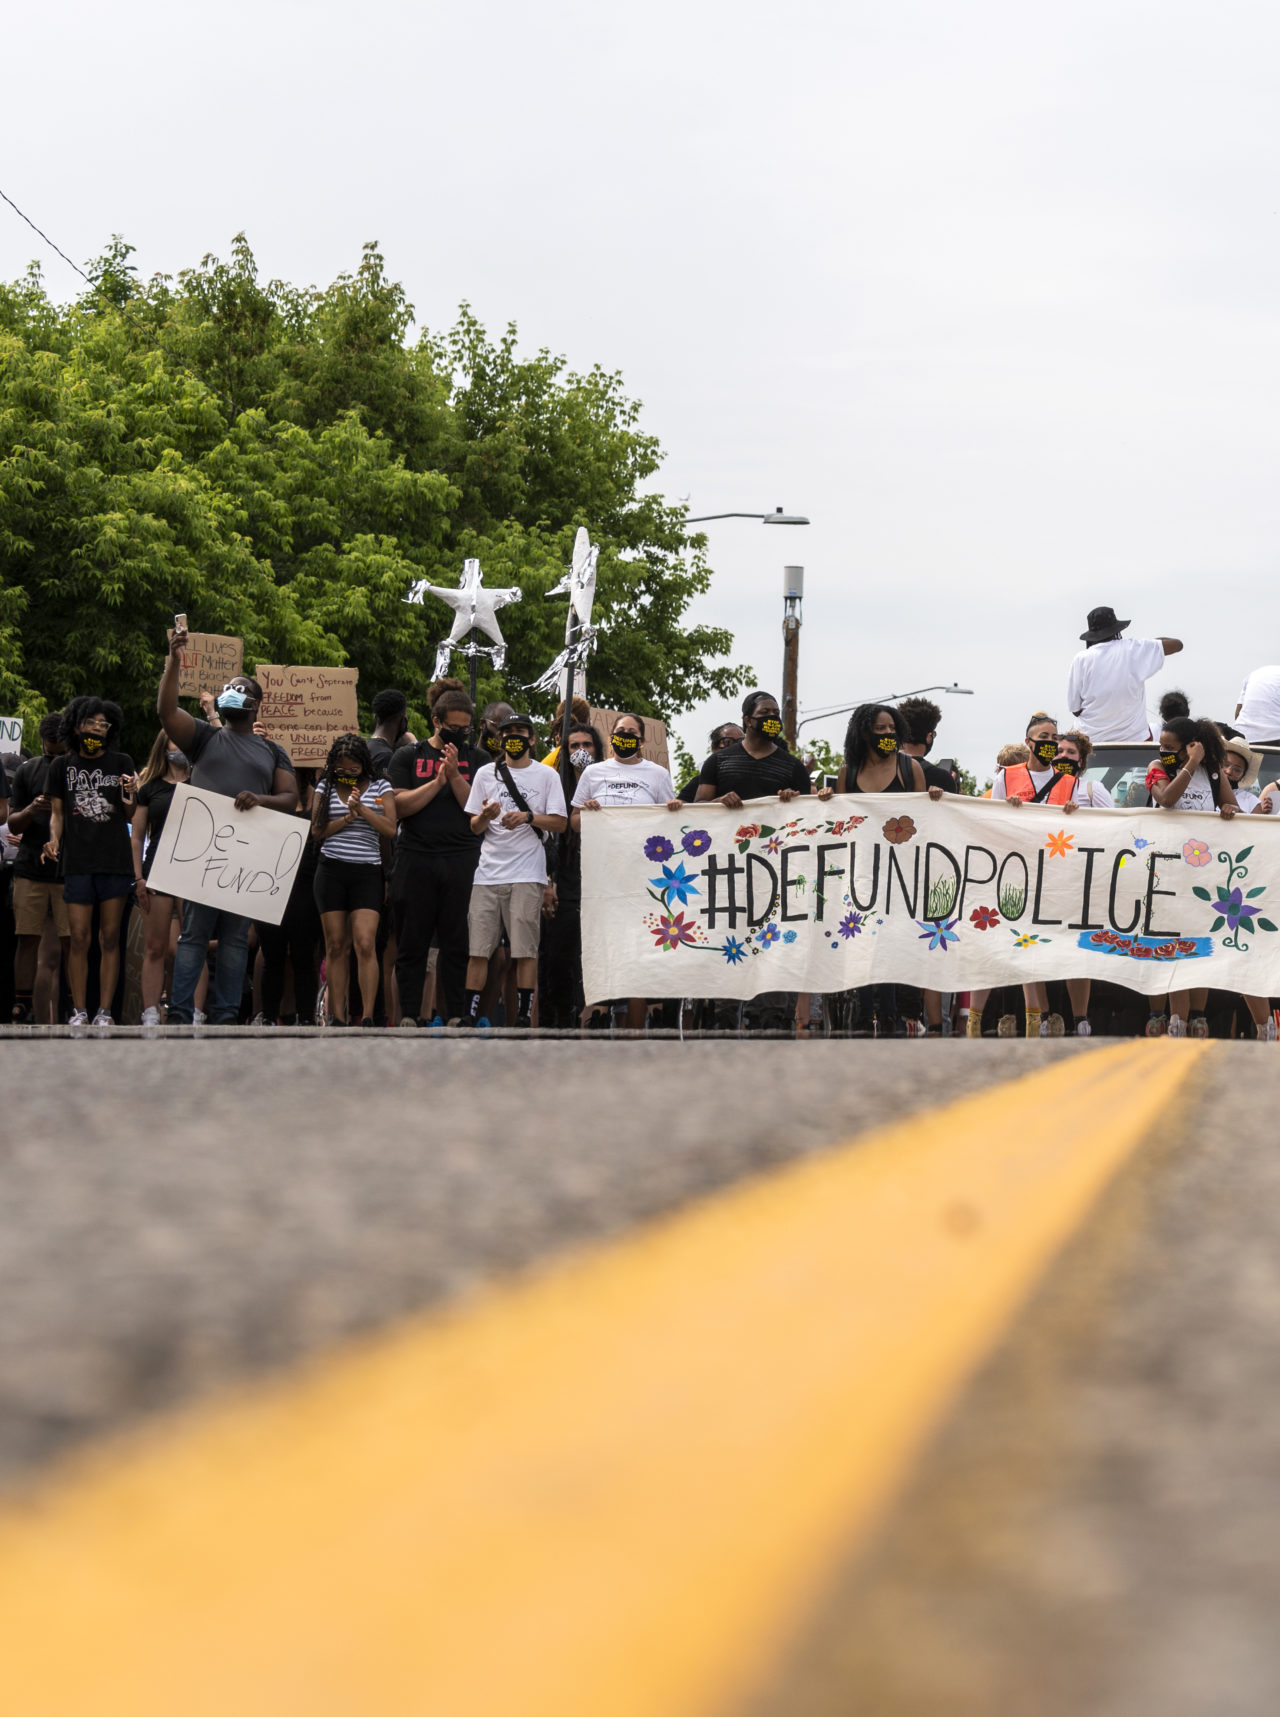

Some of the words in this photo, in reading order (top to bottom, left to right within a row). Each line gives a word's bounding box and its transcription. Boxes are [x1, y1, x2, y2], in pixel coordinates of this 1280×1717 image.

[310, 692, 332, 703] from
[261, 705, 295, 716] PEACE
[303, 707, 343, 718] because
[415, 758, 470, 780] UC
